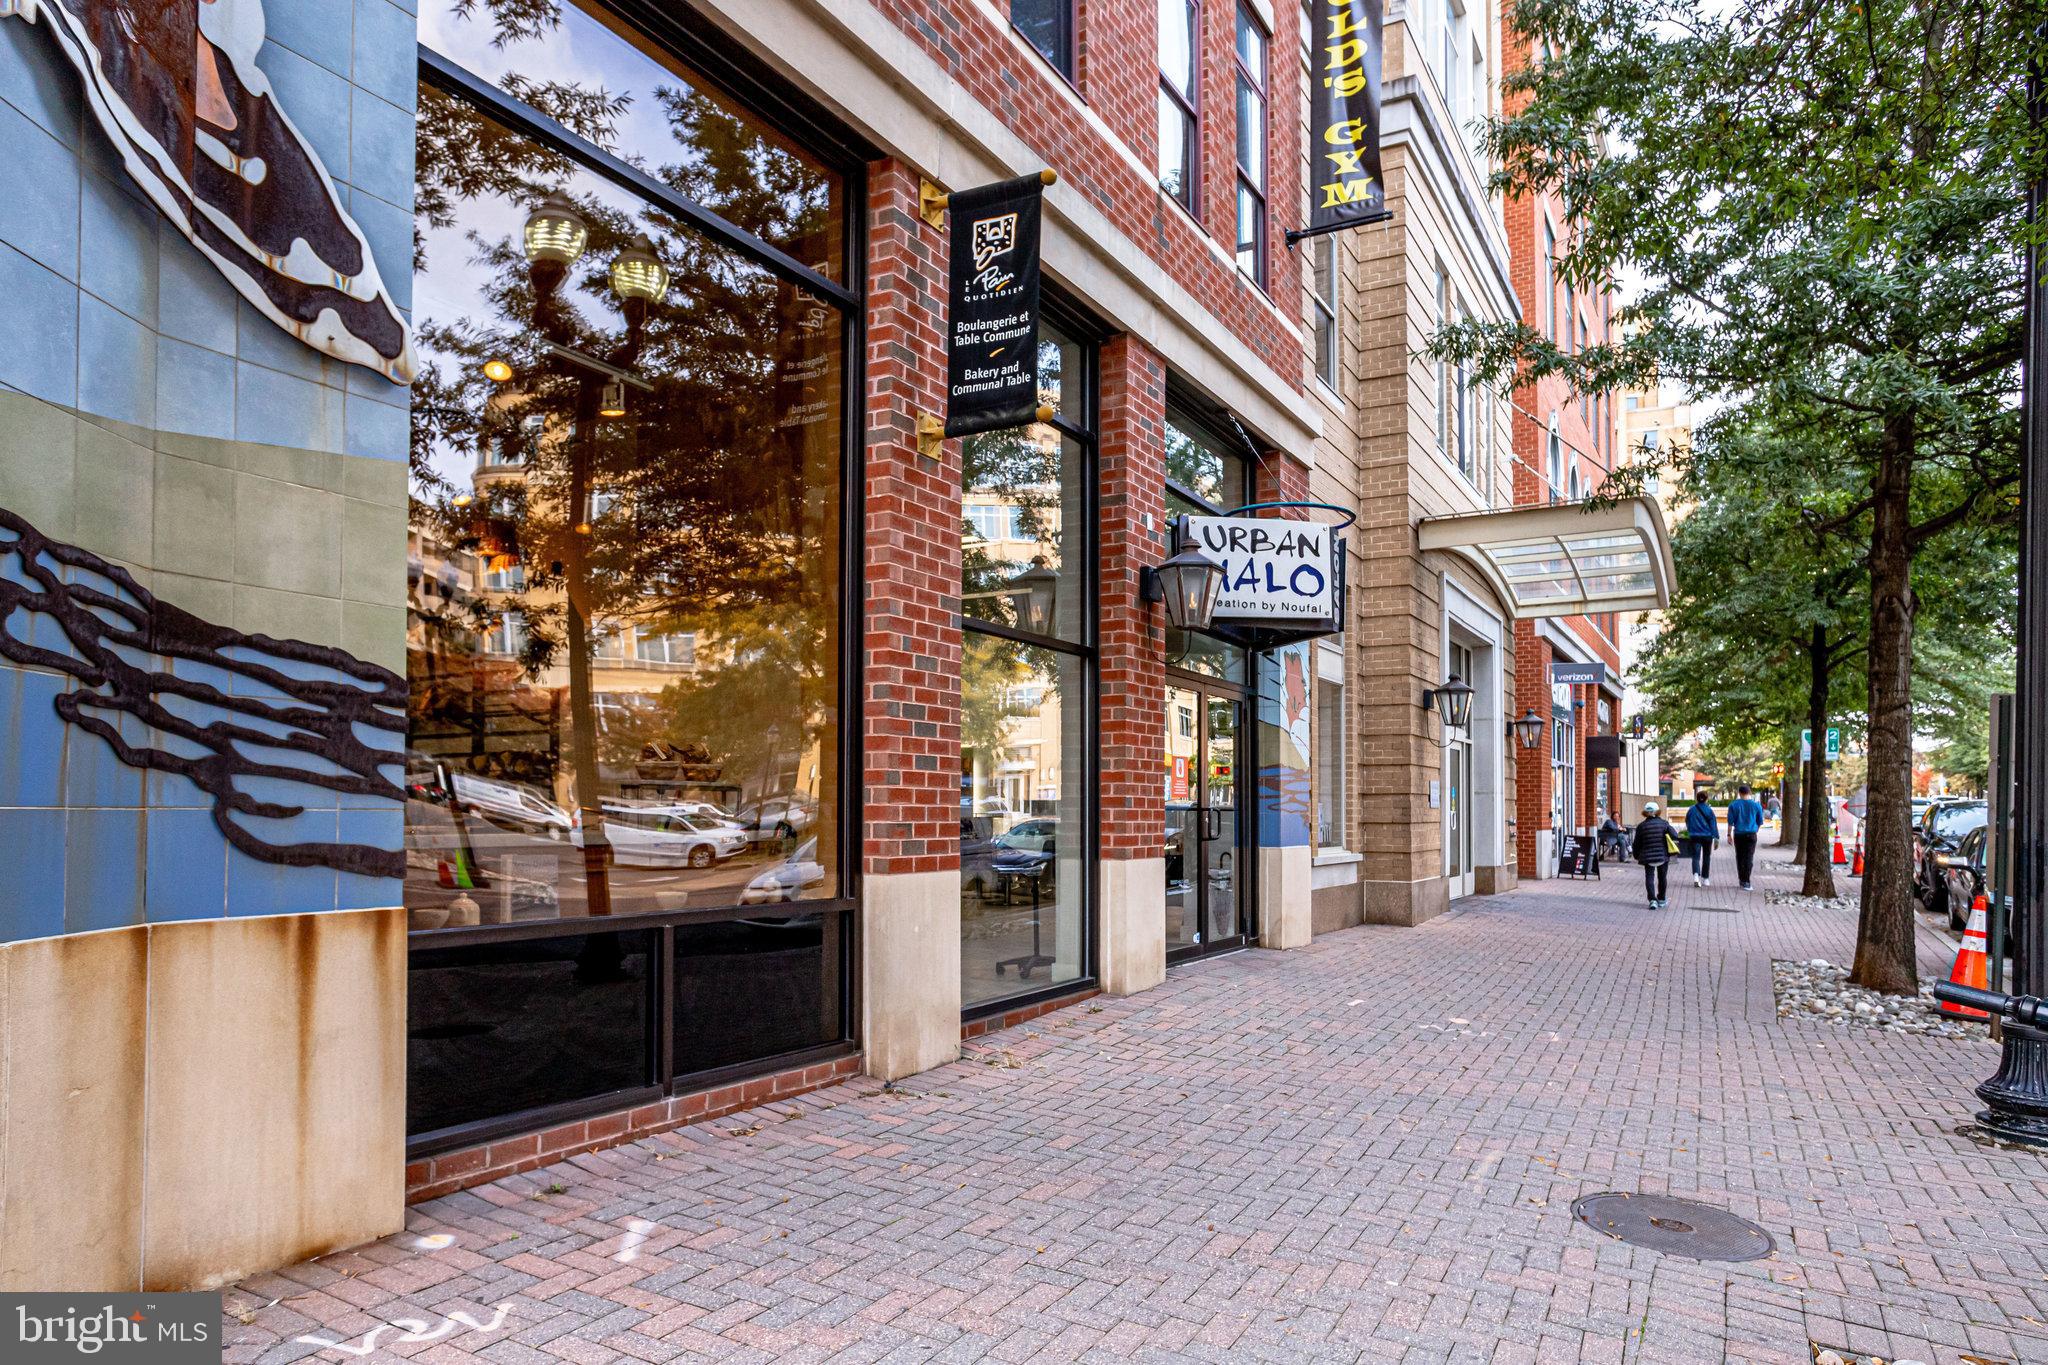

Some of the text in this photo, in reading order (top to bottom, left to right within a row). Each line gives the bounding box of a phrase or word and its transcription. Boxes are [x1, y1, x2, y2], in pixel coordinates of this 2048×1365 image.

[1320, 117, 1374, 208] GYM
[973, 266, 1014, 292] Pain
[964, 285, 1024, 302] QUOTIDIEN
[957, 310, 1029, 332] Boulangerie et
[954, 325, 1031, 346] Table Commune
[964, 361, 1019, 380] Bakery and
[952, 372, 1031, 396] Communal Table
[1202, 525, 1320, 558] URBAN
[1216, 599, 1322, 613] eation by Noufal
[1557, 673, 1594, 681] verizon
[1829, 731, 1837, 740] 2
